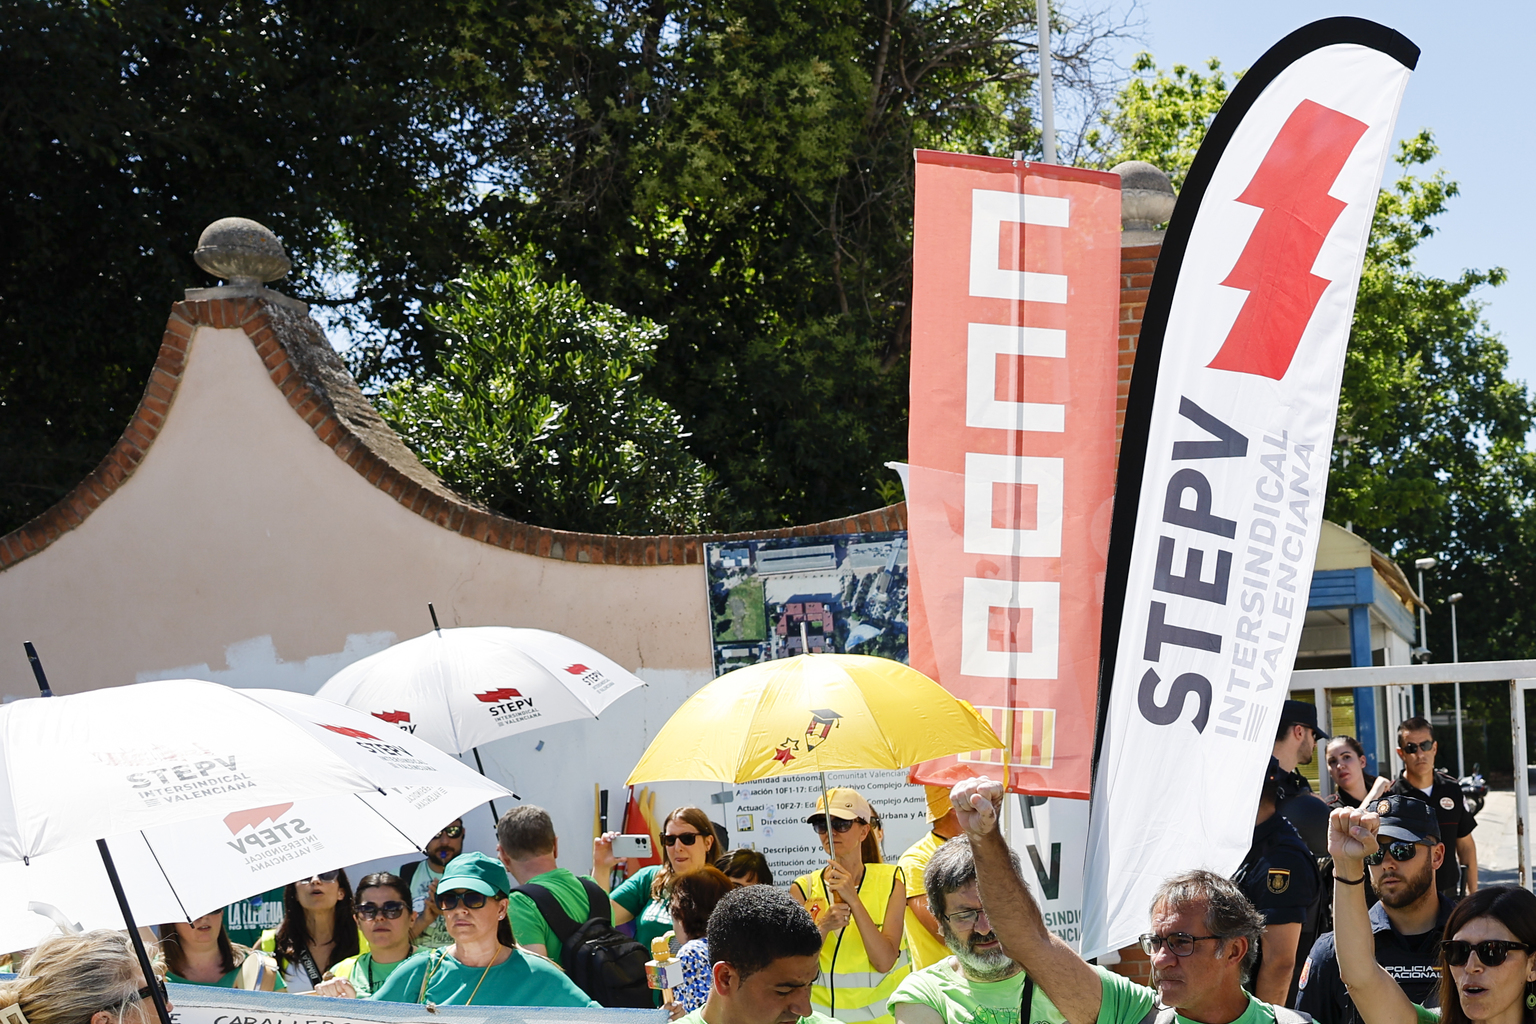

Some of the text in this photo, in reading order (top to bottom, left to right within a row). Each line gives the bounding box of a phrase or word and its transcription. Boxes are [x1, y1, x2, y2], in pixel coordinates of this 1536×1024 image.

[960, 189, 1070, 680] CCOO
[1137, 395, 1249, 735] STEPV
[1255, 442, 1316, 692] VALENCIANA
[1215, 429, 1290, 739] INTERSINDICAL
[489, 697, 534, 717] STEPV
[494, 708, 539, 722] INTERSINDICAL
[126, 755, 237, 789] STEPV
[827, 772, 867, 780] Comunitat
[869, 769, 910, 778] Valenciana
[138, 772, 251, 799] INTERSINDICAL
[163, 780, 257, 804] VALENCIANA
[775, 785, 806, 795] 10F1-17:
[867, 782, 902, 791] Complejo
[761, 816, 799, 826] Dirección
[880, 811, 908, 820] Urbana
[763, 844, 809, 854] Descripción
[811, 845, 817, 853] y
[767, 859, 805, 867] ustitución
[228, 903, 241, 925] LA
[1384, 965, 1434, 973] POLICIA
